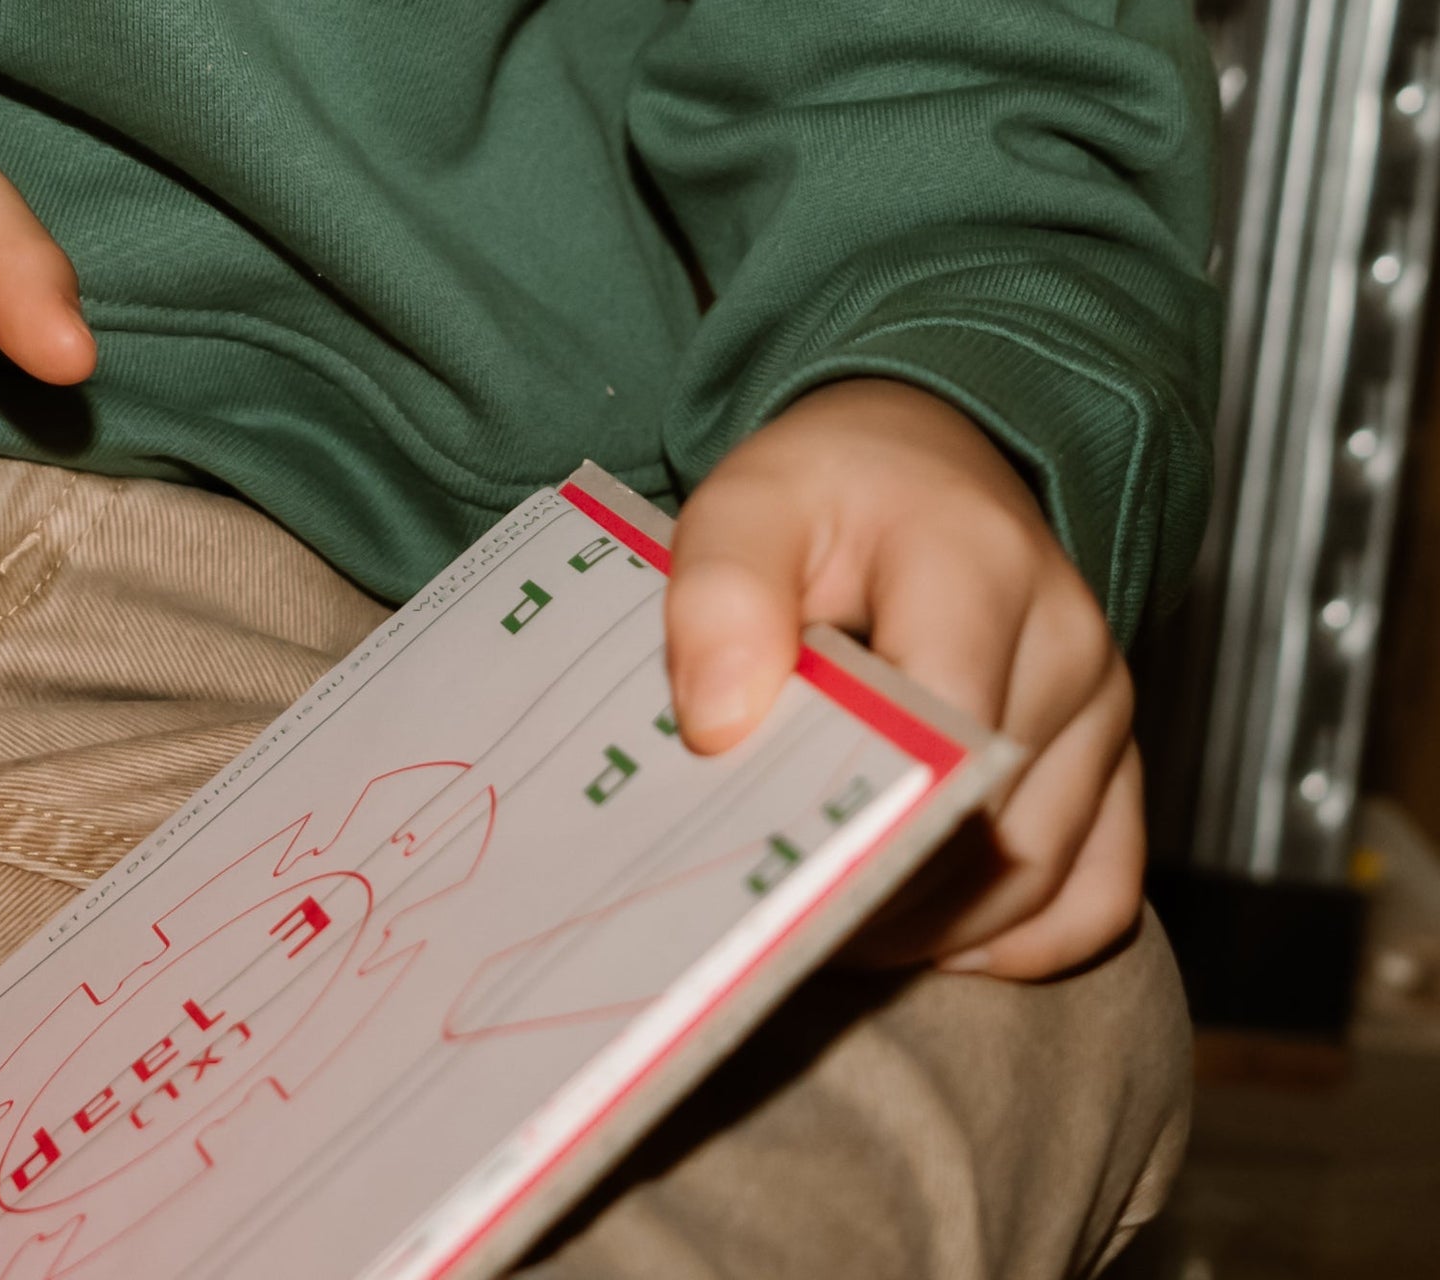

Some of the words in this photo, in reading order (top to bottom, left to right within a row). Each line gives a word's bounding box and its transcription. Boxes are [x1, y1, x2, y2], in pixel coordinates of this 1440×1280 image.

[47, 914, 78, 943] LET
[85, 880, 118, 910] OP!
[126, 851, 152, 875] DE
[155, 726, 290, 849] STOELHOOGTE
[296, 704, 313, 721] IS
[317, 674, 345, 701] NU
[376, 622, 405, 648] CM
[413, 574, 458, 613] WILT
